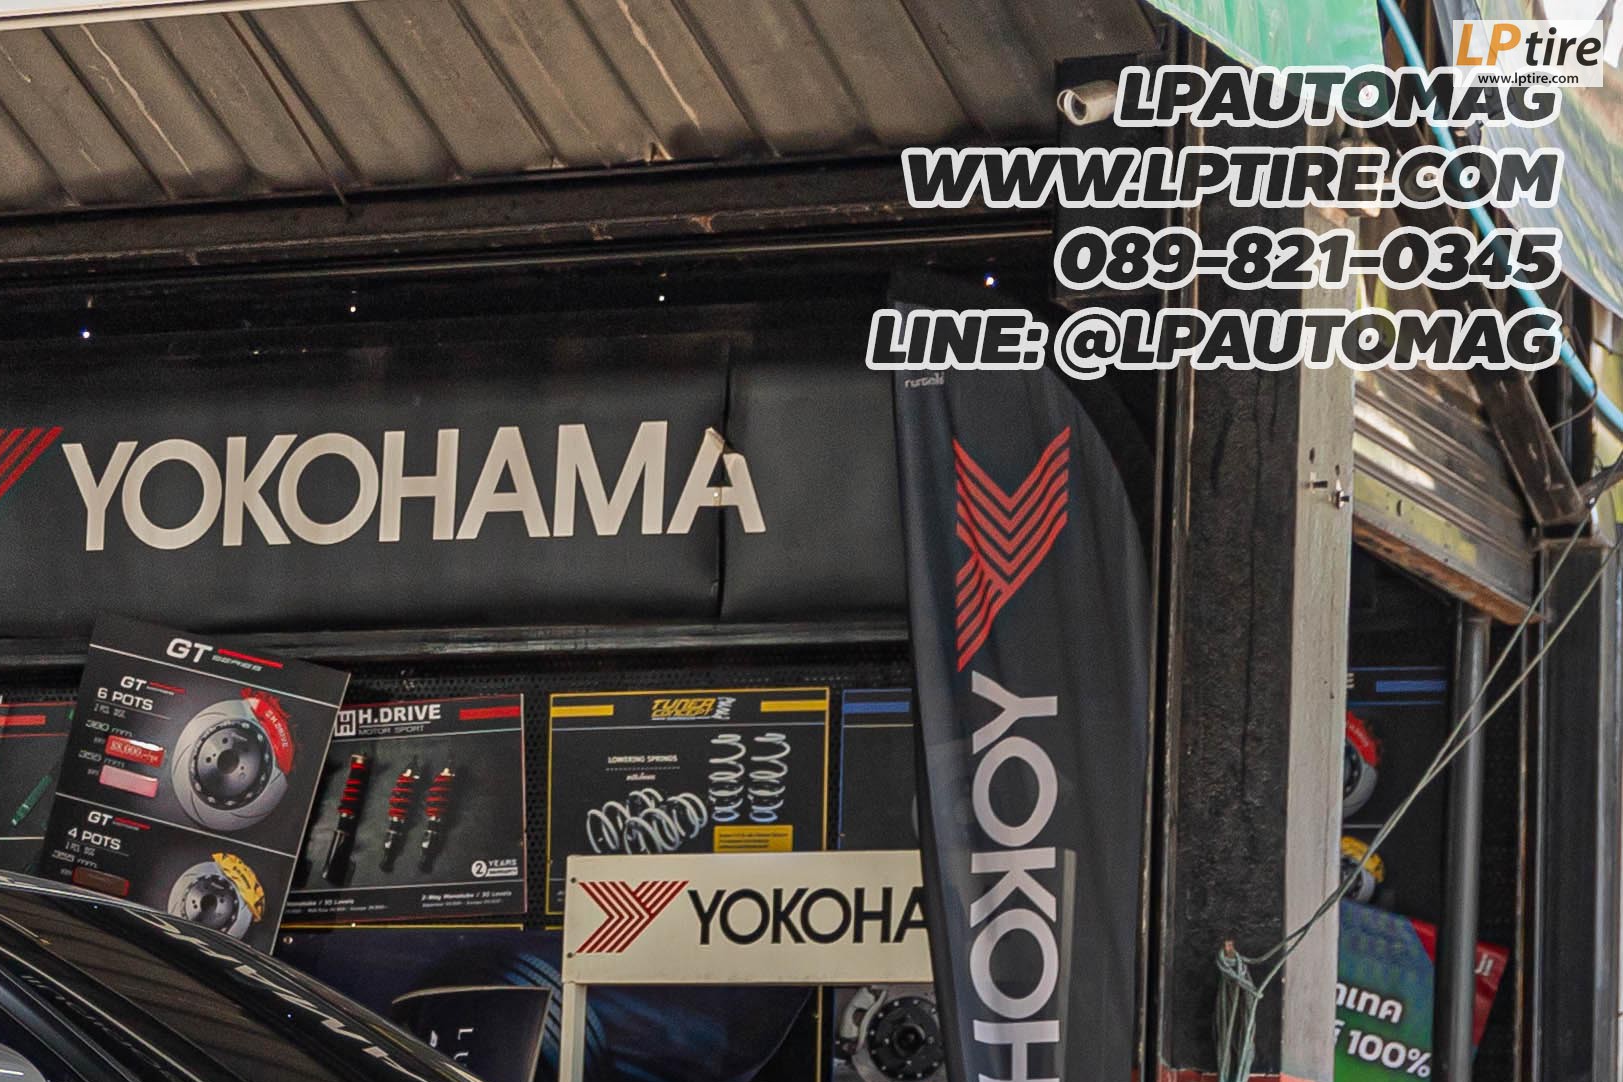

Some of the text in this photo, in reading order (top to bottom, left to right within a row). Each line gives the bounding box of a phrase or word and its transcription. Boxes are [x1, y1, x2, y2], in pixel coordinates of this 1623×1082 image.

[62, 420, 767, 551] YOKOHAMA
[166, 637, 213, 663] GT
[120, 675, 147, 691] GT
[97, 687, 109, 700] 6
[111, 690, 154, 711] POTS
[358, 703, 441, 725] H.DRIVE
[87, 810, 114, 826] GT
[68, 827, 78, 839] 4
[81, 830, 121, 850] POTS
[688, 887, 929, 945] YOKOHA
[1347, 1030, 1431, 1078] 100%
